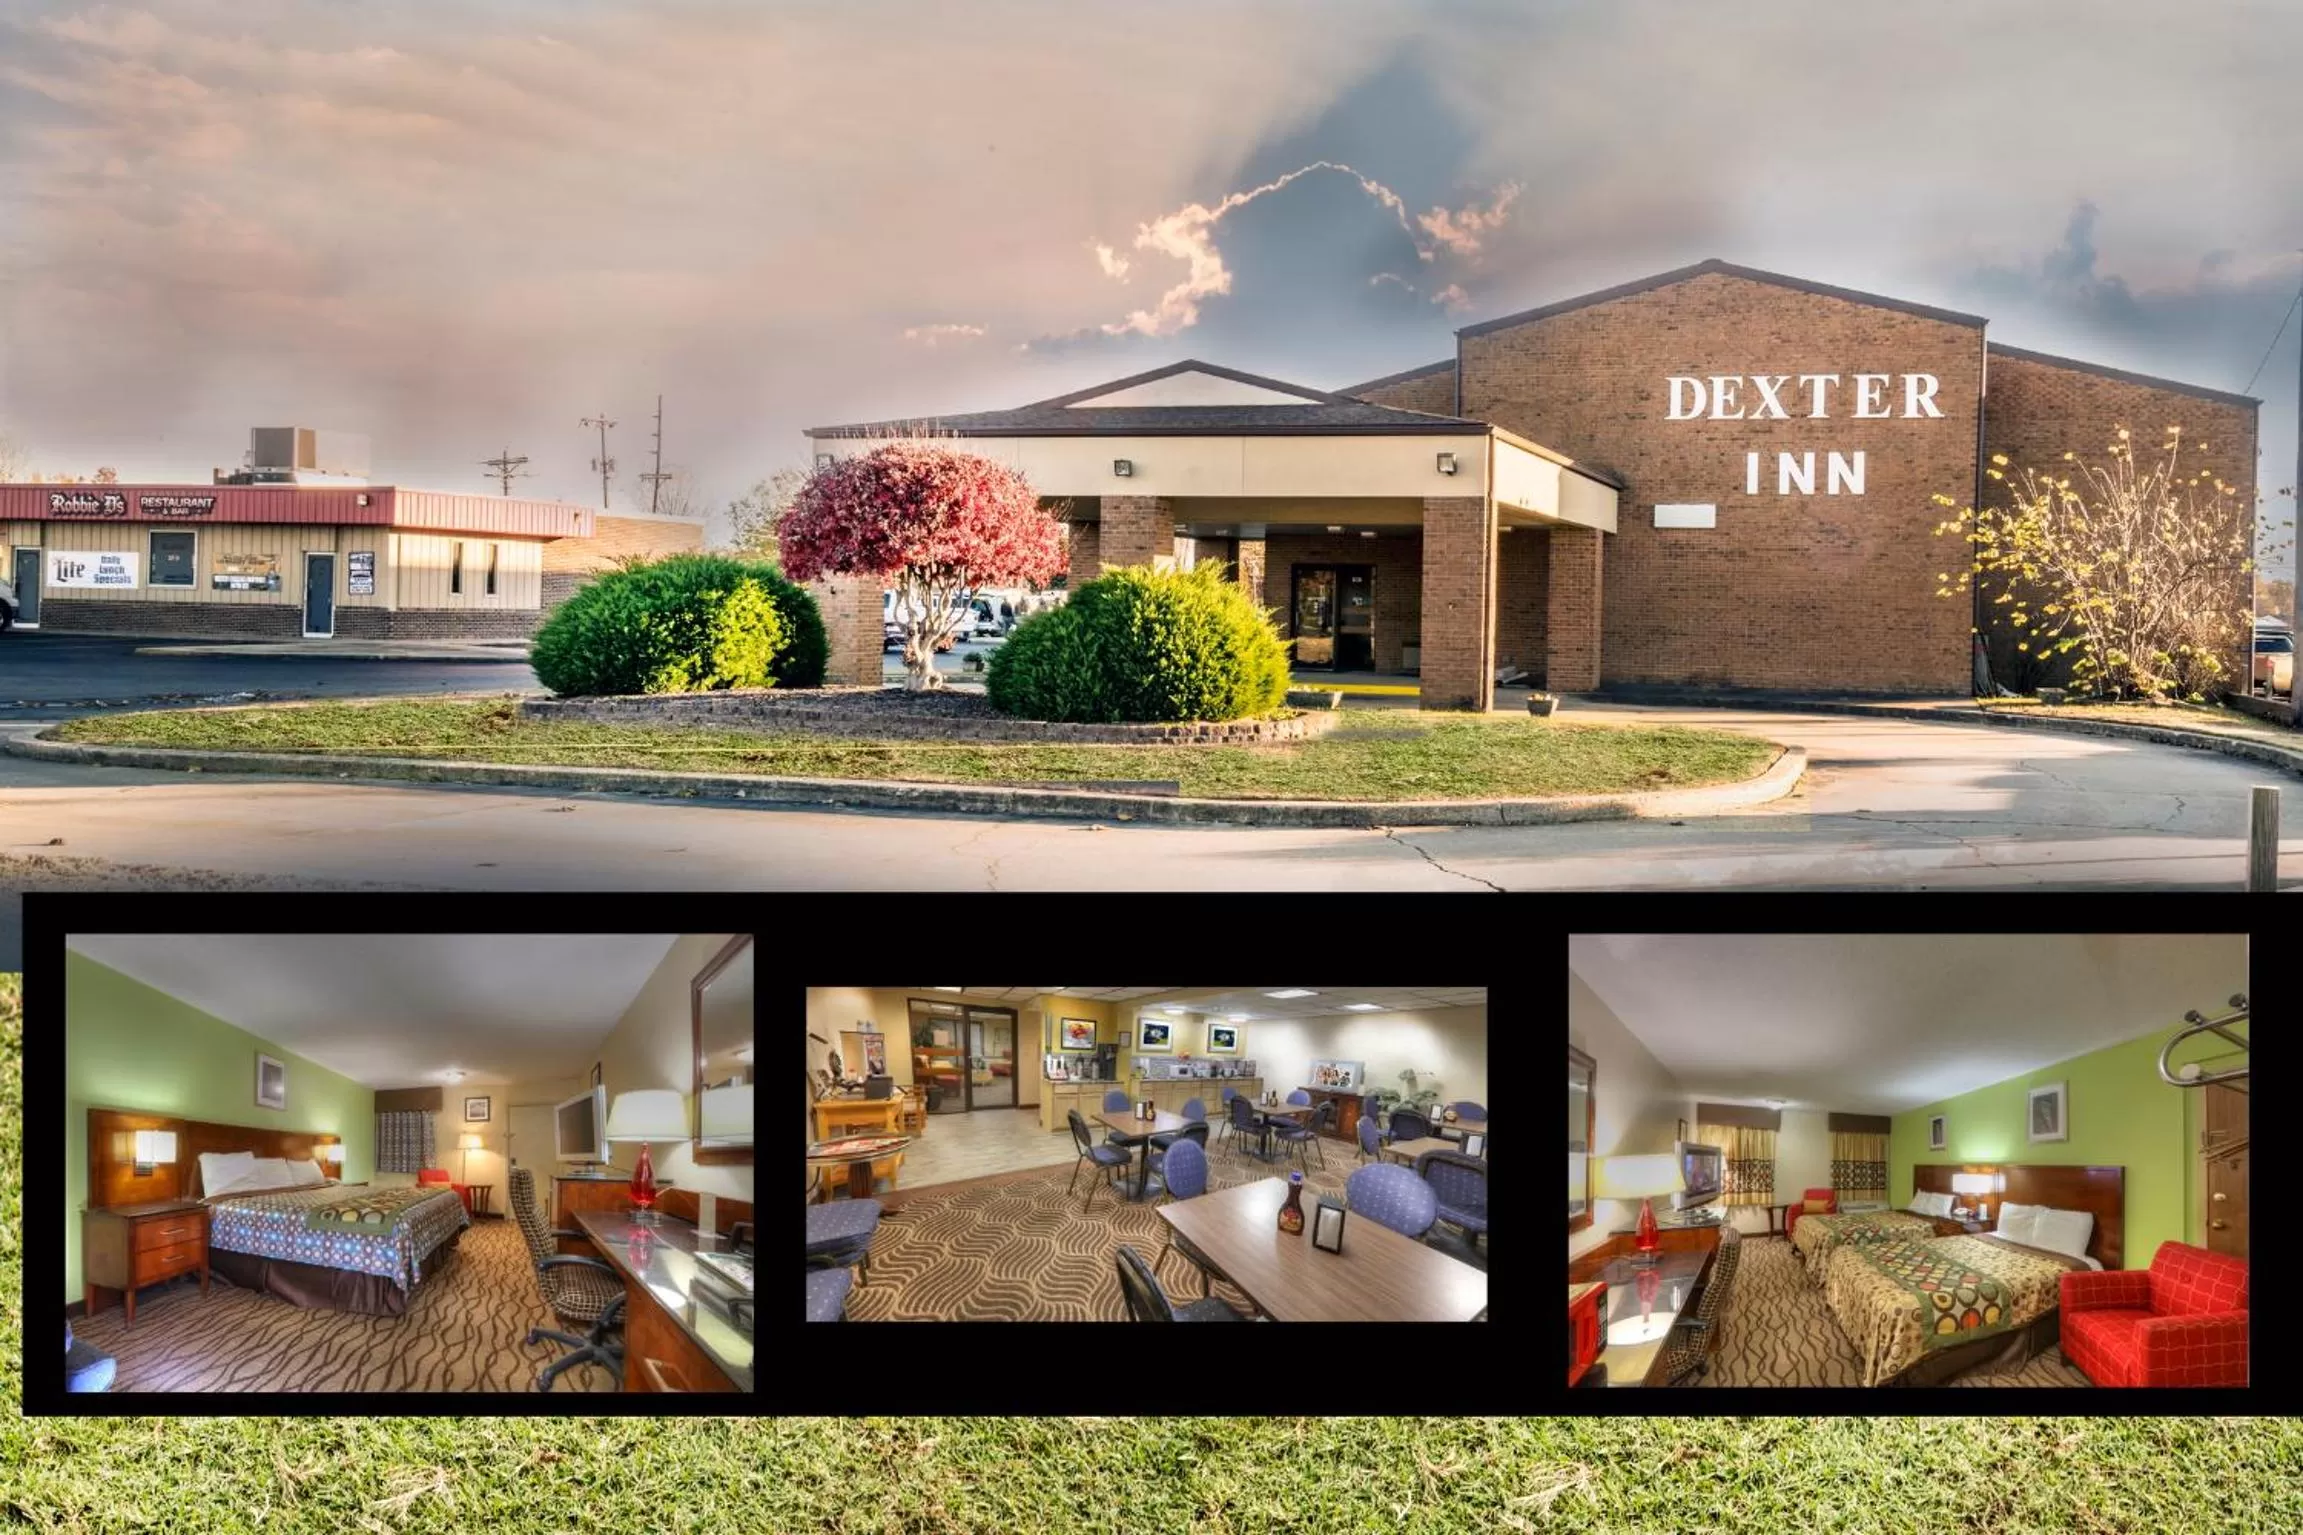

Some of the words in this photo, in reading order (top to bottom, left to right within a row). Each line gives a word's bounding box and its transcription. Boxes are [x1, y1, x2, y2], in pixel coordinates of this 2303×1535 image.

[1664, 373, 1945, 420] DEXTER
[1746, 450, 1865, 495] INN
[50, 493, 100, 514] Robbie
[140, 496, 214, 508] RESTAURANT
[163, 507, 169, 515] &
[171, 507, 189, 515] BAR
[56, 559, 86, 582] Lite
[99, 565, 125, 575] Lunch
[94, 573, 132, 584] Specials
